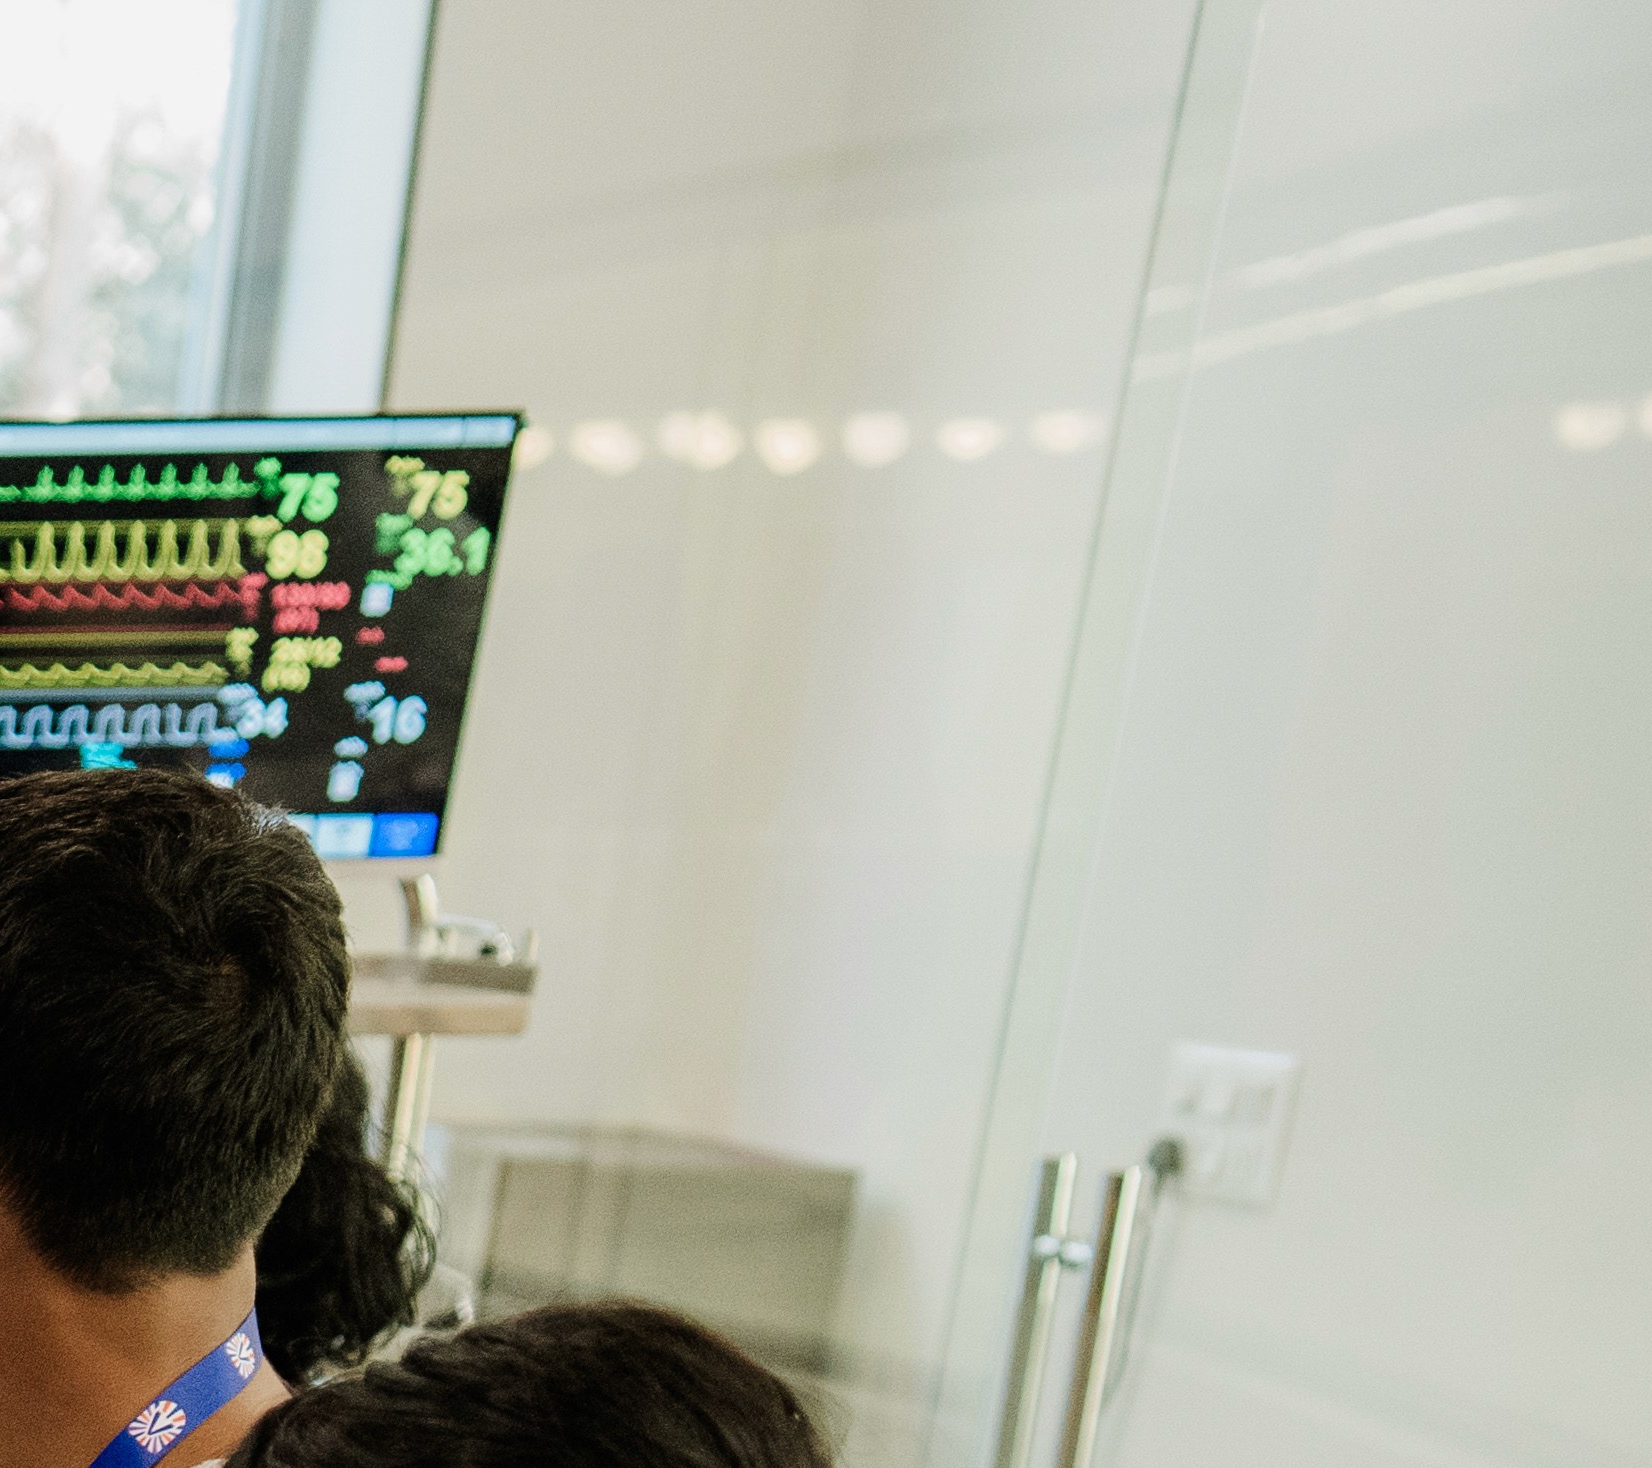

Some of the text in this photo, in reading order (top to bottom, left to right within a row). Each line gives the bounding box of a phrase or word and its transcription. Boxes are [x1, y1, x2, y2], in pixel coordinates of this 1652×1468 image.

[279, 472, 340, 523] 75
[409, 469, 470, 520] 75
[367, 695, 428, 744] 16
